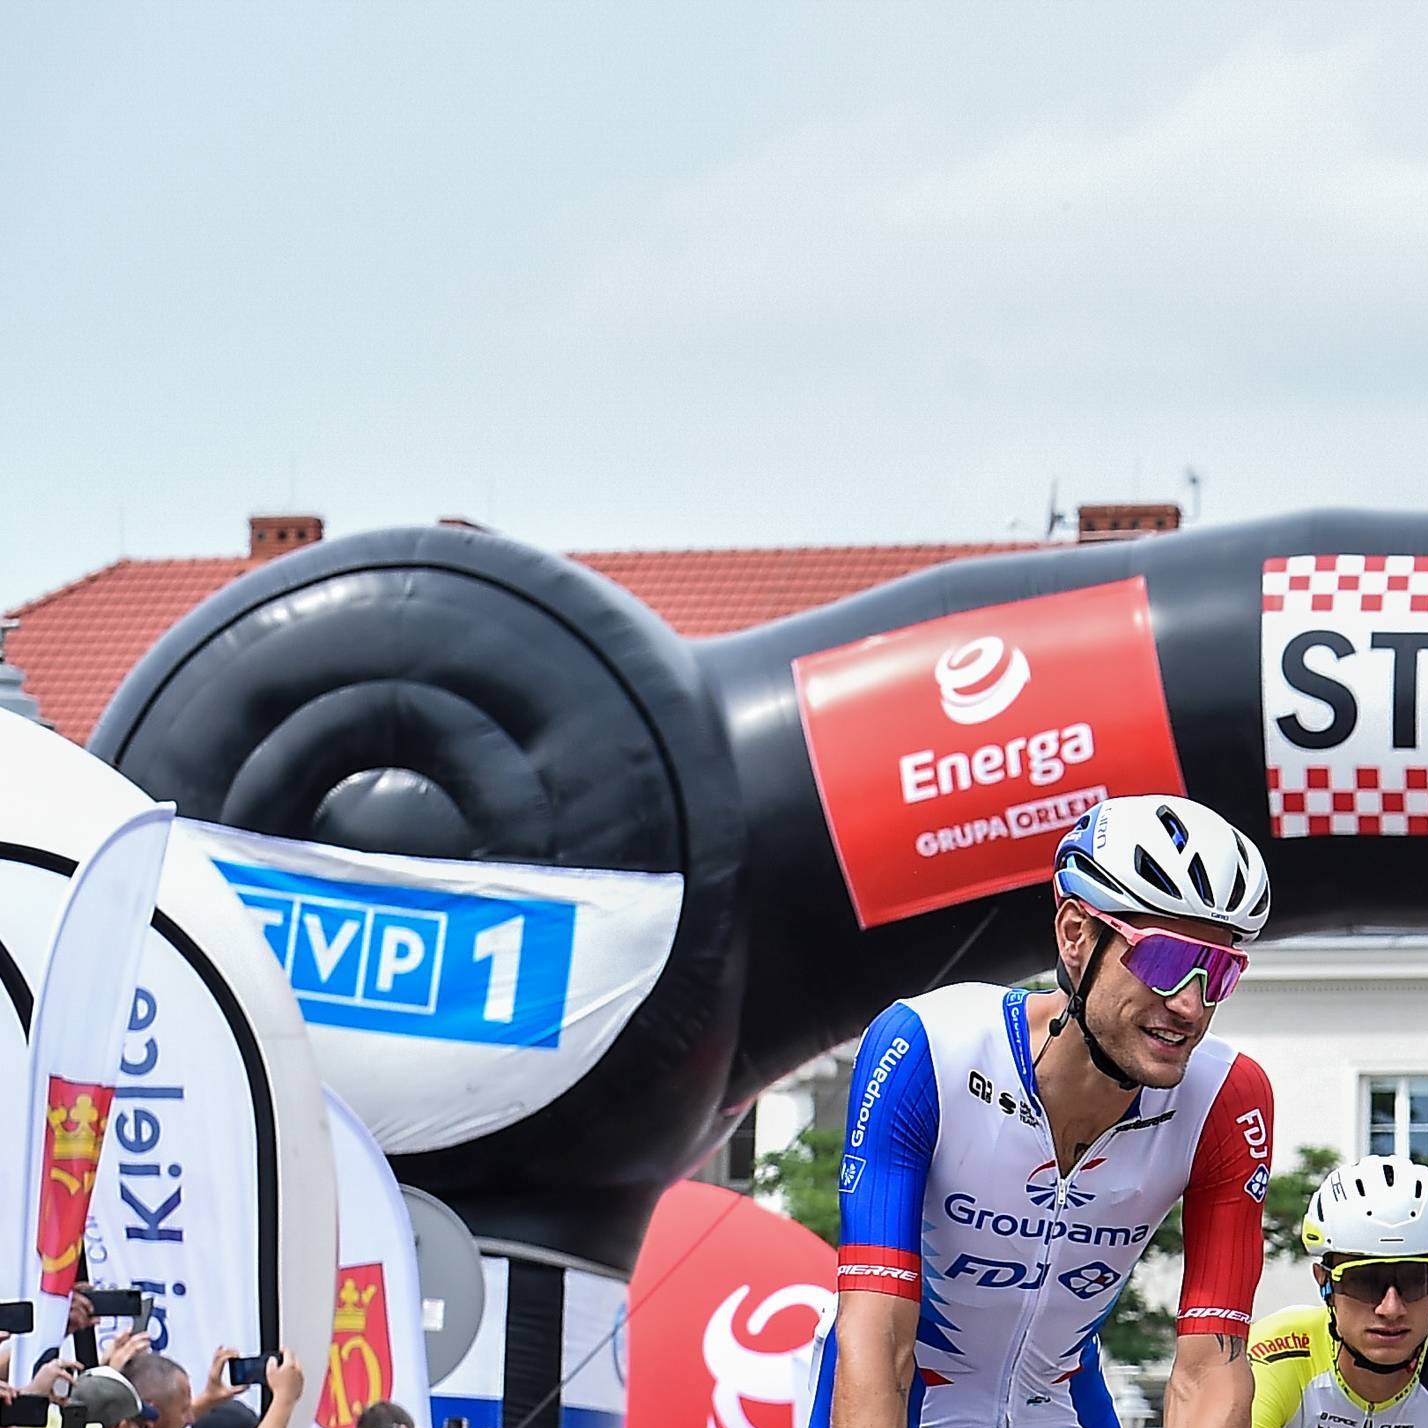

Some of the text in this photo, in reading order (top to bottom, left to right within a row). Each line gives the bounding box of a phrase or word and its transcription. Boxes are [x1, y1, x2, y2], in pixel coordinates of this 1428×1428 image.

[899, 722, 1094, 804] Energa
[915, 790, 1104, 857] GRUPA ORLEN
[473, 914, 524, 1023] 1
[851, 1037, 910, 1147] Groupama
[1237, 1108, 1269, 1158] FDJ
[944, 1192, 1150, 1248] Groupama
[944, 1253, 1050, 1290] FDJ
